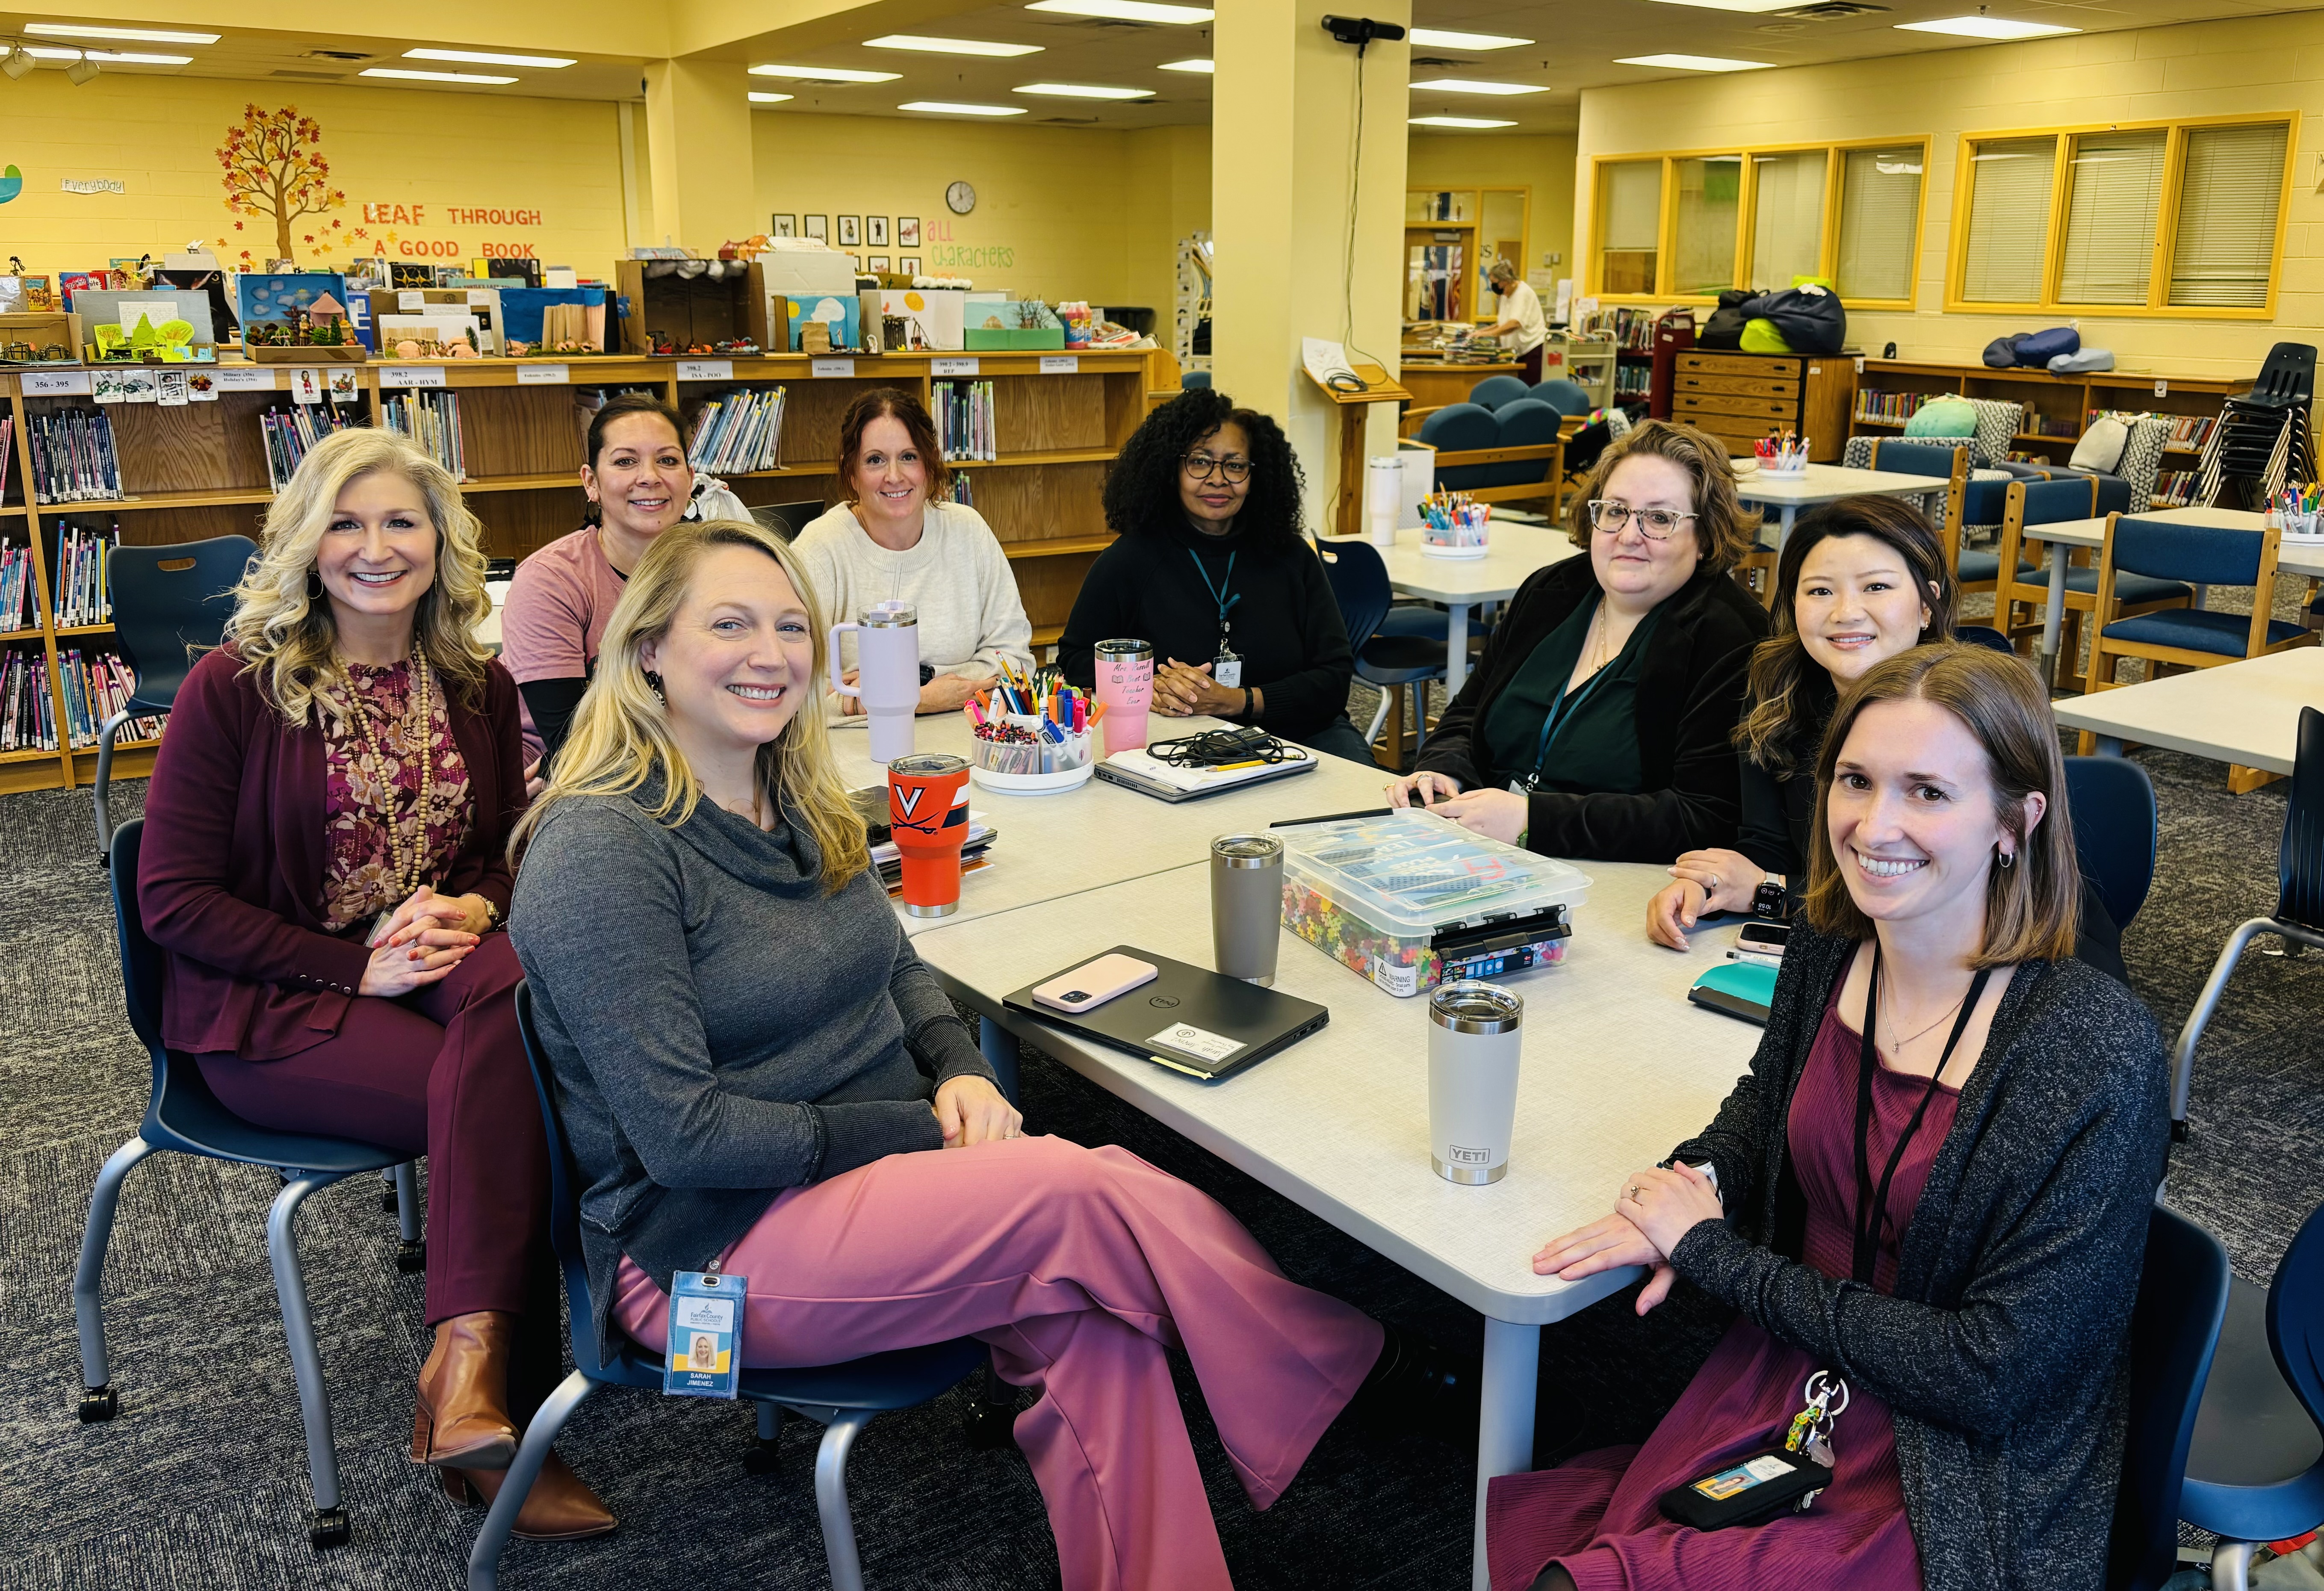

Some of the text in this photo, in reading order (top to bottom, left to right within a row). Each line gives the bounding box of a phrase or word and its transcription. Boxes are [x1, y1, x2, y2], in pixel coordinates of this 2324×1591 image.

[363, 204, 541, 225] LEAF THROUGH
[374, 239, 535, 259] A GOOD BOOK
[1127, 675, 1140, 683] Best
[893, 783, 927, 821] V
[1389, 973, 1410, 983] WARNING
[1452, 1148, 1486, 1162] YETI
[706, 1313, 723, 1321] County
